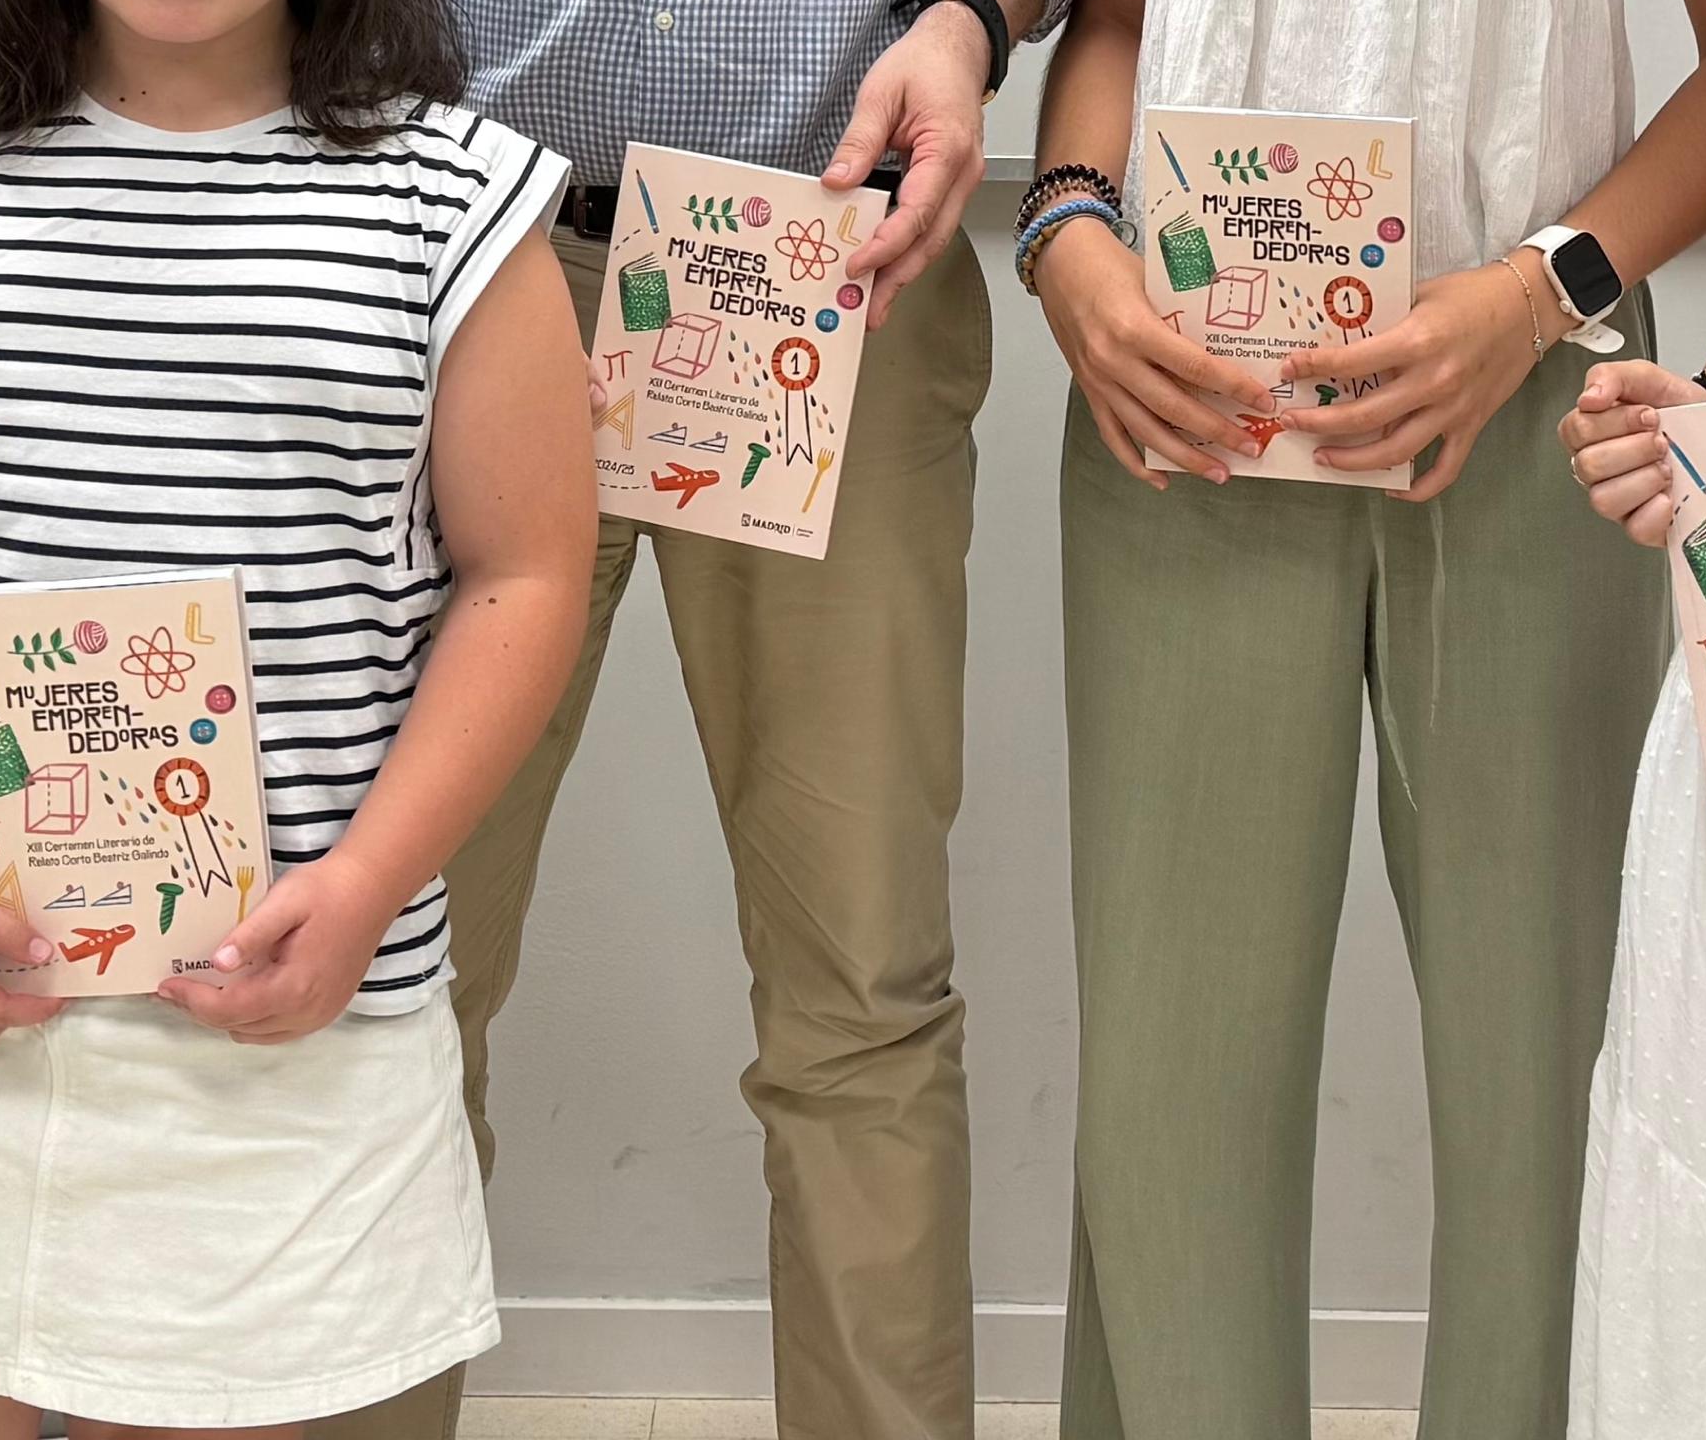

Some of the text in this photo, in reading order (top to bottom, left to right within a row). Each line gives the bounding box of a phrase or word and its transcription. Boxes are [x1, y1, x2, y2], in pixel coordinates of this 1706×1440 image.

[1202, 193, 1303, 219] MUJERES
[1223, 216, 1323, 242] EMPREN-
[667, 236, 767, 274] MUJERES
[1253, 240, 1350, 266] DEDORAS
[684, 262, 783, 299] EMPREN-
[709, 289, 806, 327] DEDORAS
[1342, 290, 1355, 314] 1
[790, 351, 801, 376] 1
[4, 680, 119, 710] MUJERES
[31, 703, 144, 733] EMPREN-
[67, 724, 179, 754] DEDORAS
[175, 774, 190, 800] 1
